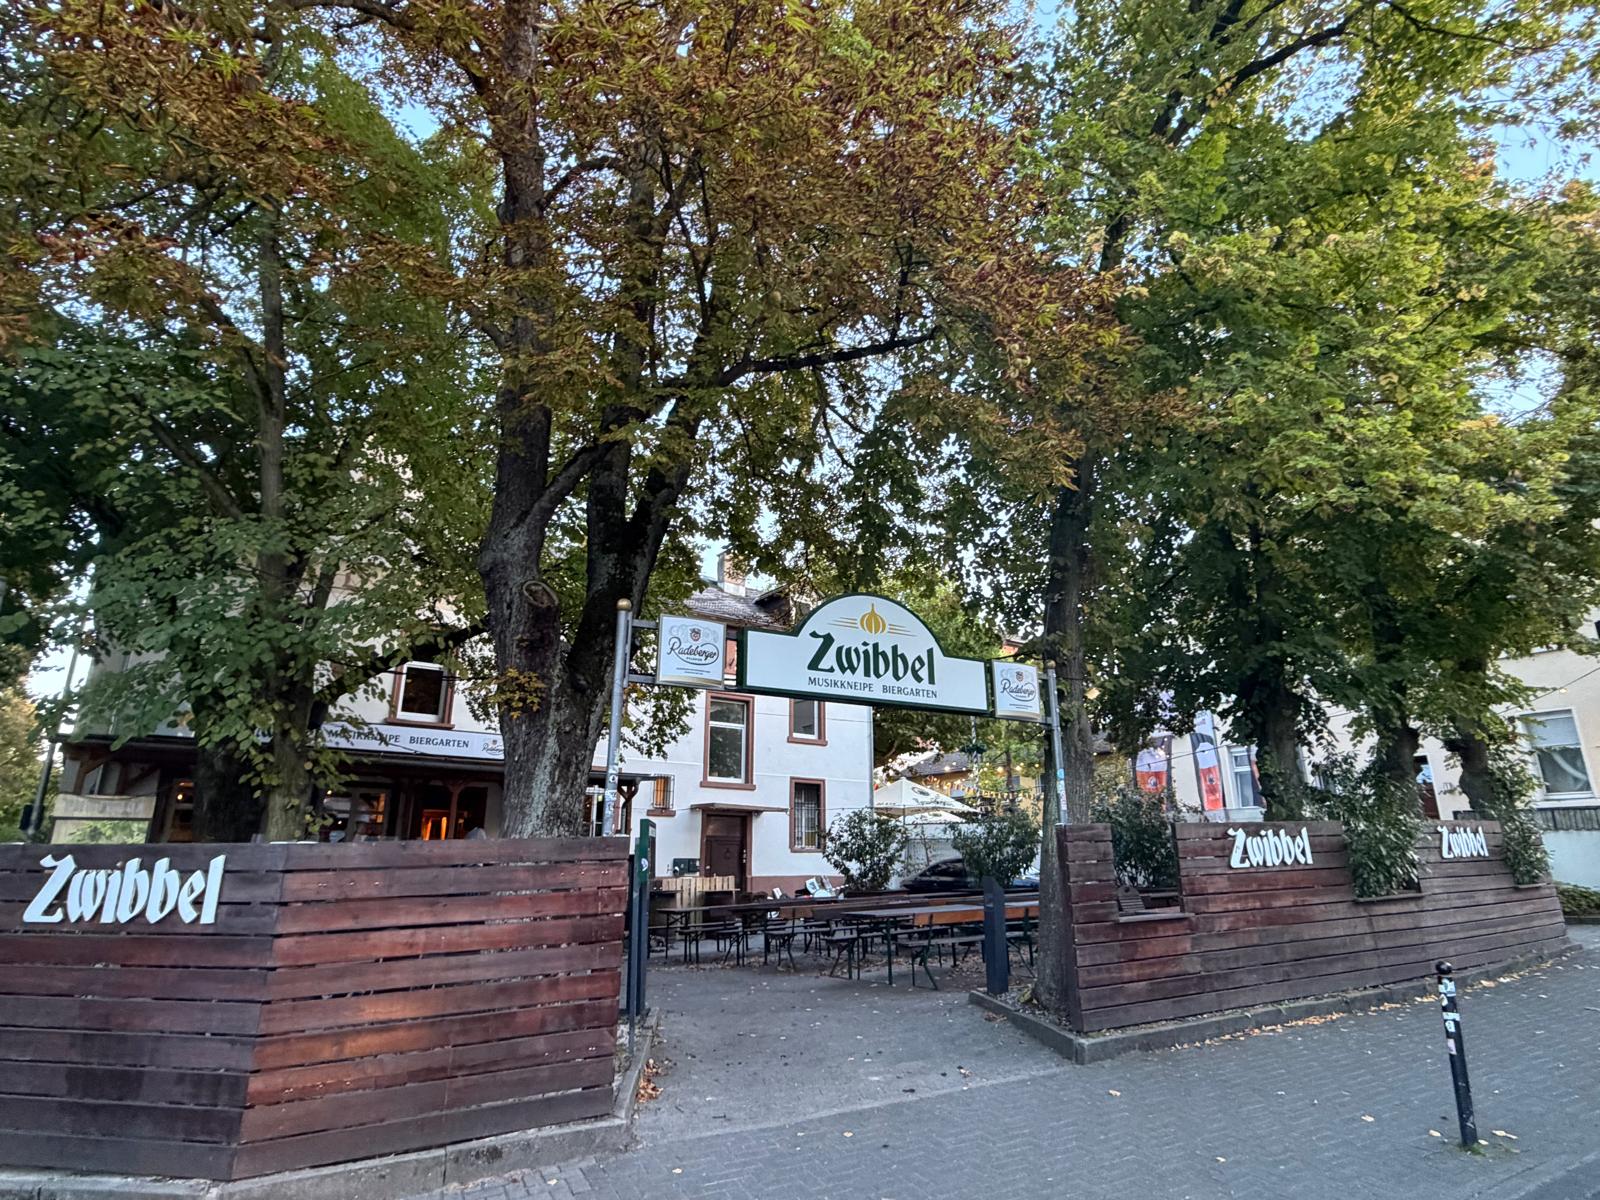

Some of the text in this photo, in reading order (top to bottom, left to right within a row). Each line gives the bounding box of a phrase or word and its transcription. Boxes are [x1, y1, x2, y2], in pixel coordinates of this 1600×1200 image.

[667, 637, 719, 664] Radeberger
[807, 630, 936, 685] Zwibbel
[808, 676, 938, 699] MUSIKKNEIPE BIERGARTEN
[409, 735, 470, 748] BIERGARTEN
[1227, 826, 1314, 869] Zwibbel
[1437, 825, 1489, 859] Zwibbel
[22, 854, 227, 925] Zwibbel
